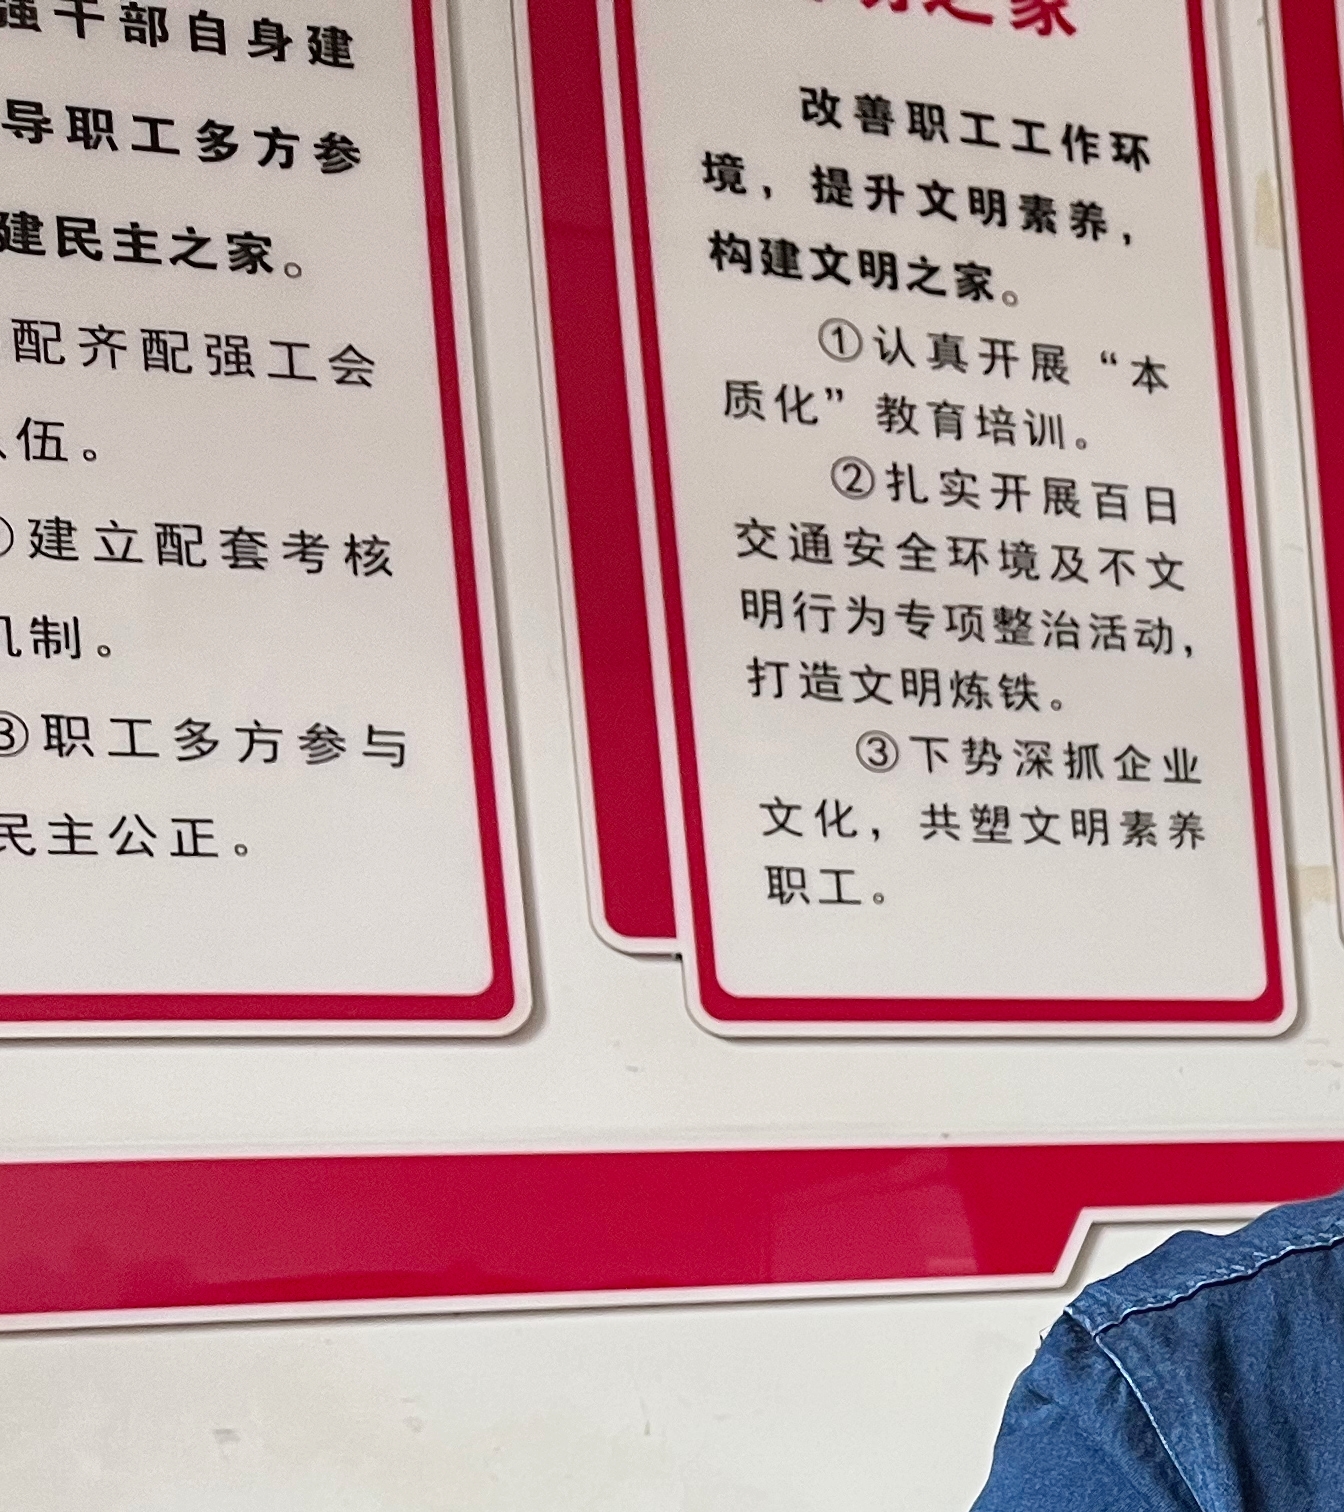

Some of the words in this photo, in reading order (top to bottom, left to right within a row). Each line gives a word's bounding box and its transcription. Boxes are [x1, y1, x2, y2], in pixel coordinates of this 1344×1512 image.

[1, 98, 361, 174] 导职工多方参
[800, 86, 1151, 172] 改善职工工作环
[709, 230, 1018, 307] 构建文明之家。
[12, 318, 376, 388] 配齐配强工会
[0, 417, 98, 462] 伍。
[831, 456, 1177, 525] ②扎实开展百日
[735, 517, 1185, 592] 交通安全环境及不文
[742, 588, 1193, 658] 明行为专项整治活动，
[747, 656, 1062, 712] 打造文明炼铁。
[856, 730, 1201, 784] ③下势深抓企业
[760, 796, 1205, 849] 文化，共塑文明素养
[764, 865, 884, 906] 职工。
